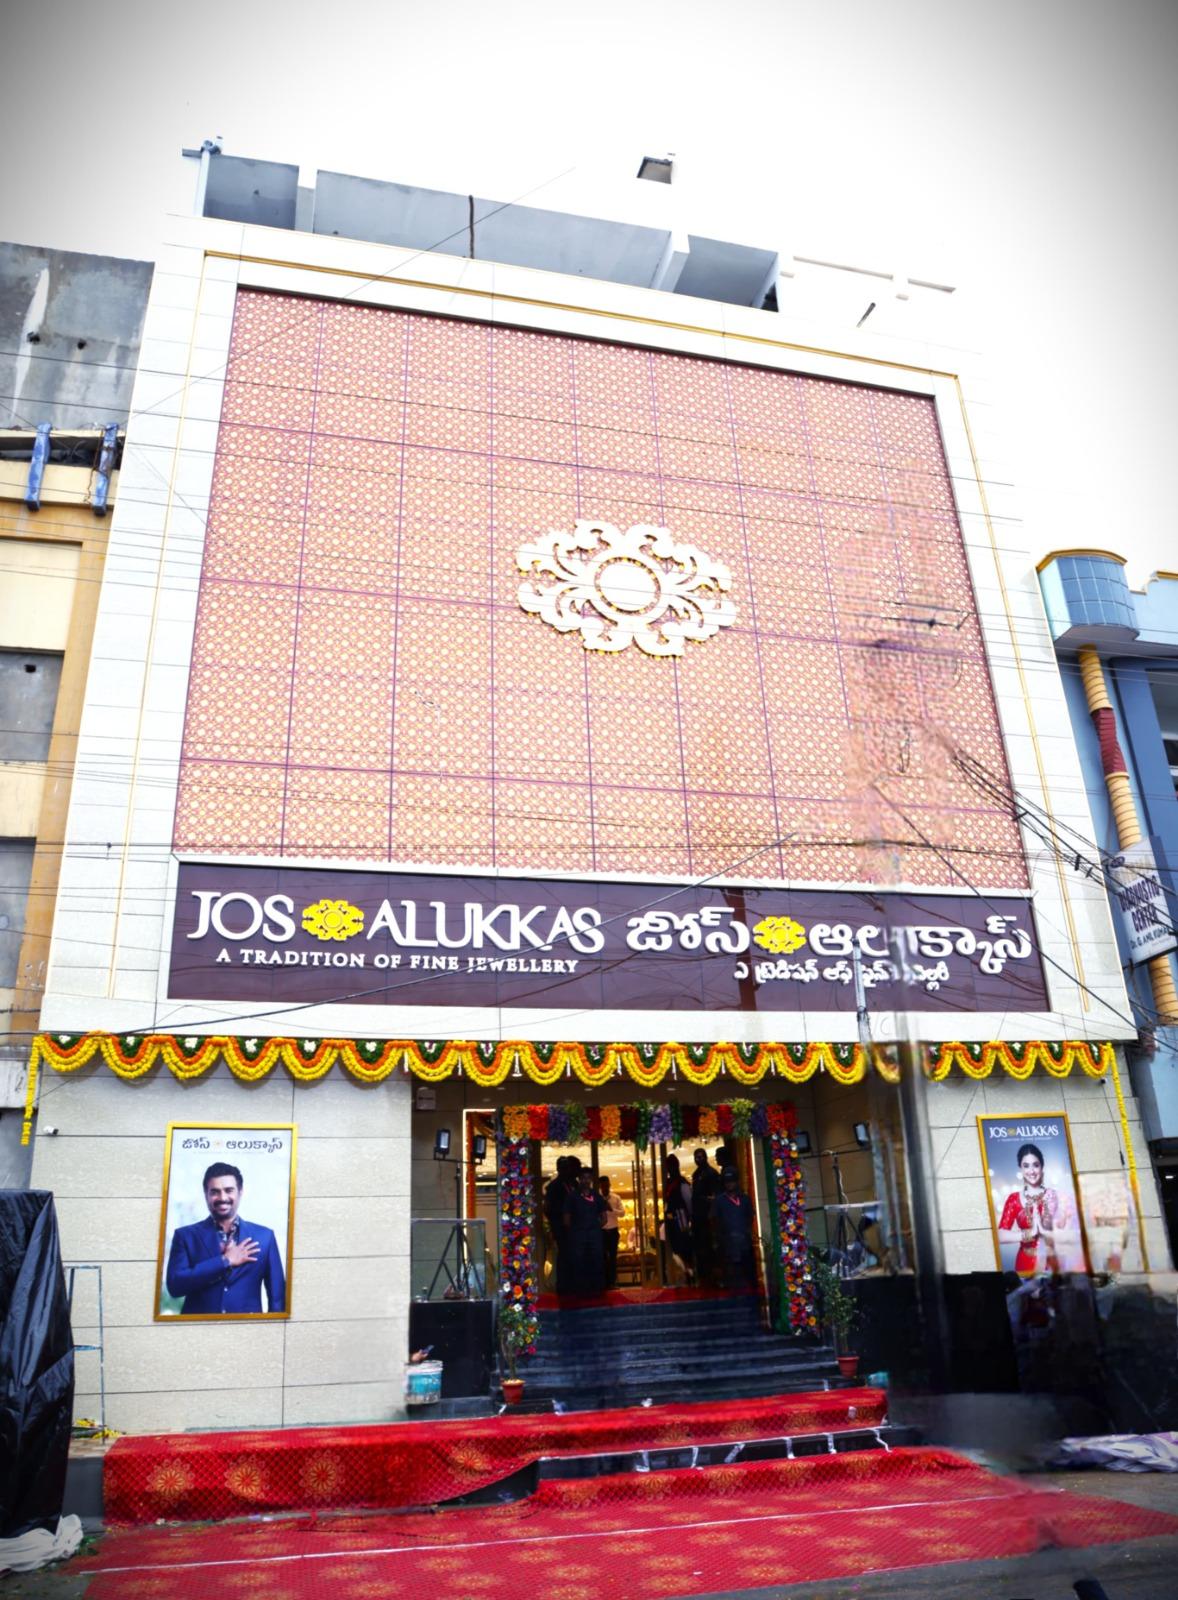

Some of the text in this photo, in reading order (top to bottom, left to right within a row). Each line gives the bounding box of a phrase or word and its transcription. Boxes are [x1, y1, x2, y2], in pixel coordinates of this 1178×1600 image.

[187, 891, 604, 953] JOS ALUKKAS
[626, 906, 750, 953] జోస్
[215, 948, 579, 974] A TRADITION OF FINE JEWELLERY
[182, 1137, 210, 1149] జోస్
[989, 1125, 1059, 1138] JOS ALUKKAS
